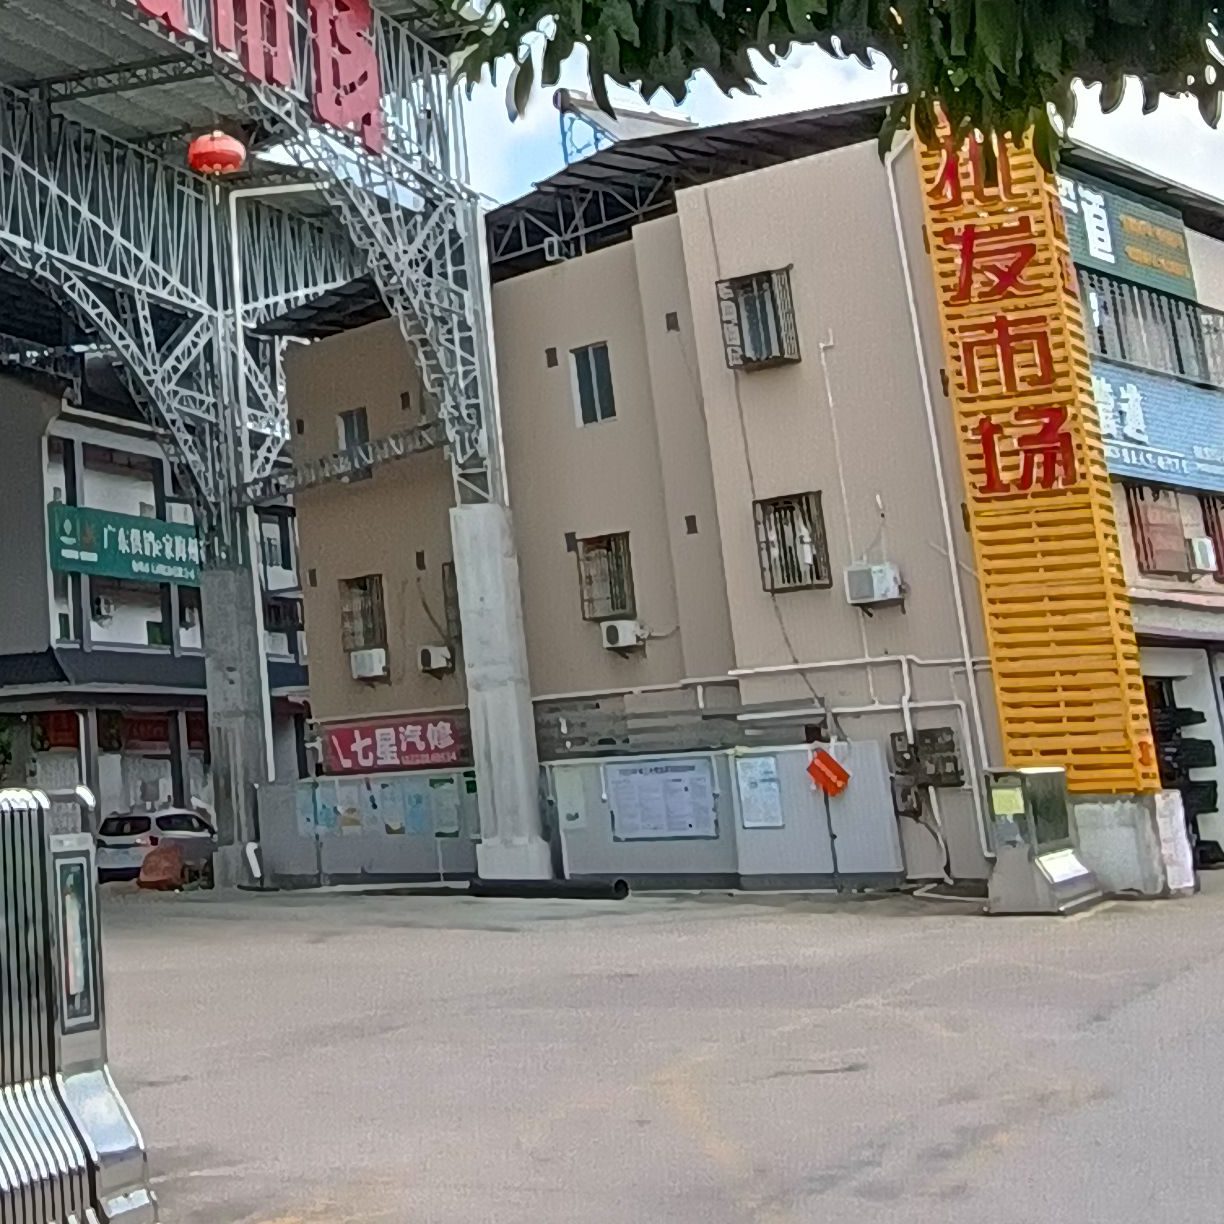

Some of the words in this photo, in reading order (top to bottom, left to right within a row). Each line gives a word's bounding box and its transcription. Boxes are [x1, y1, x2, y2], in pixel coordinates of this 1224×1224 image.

[926, 126, 1077, 494] 批发市场
[350, 720, 455, 767] 七星汽修
